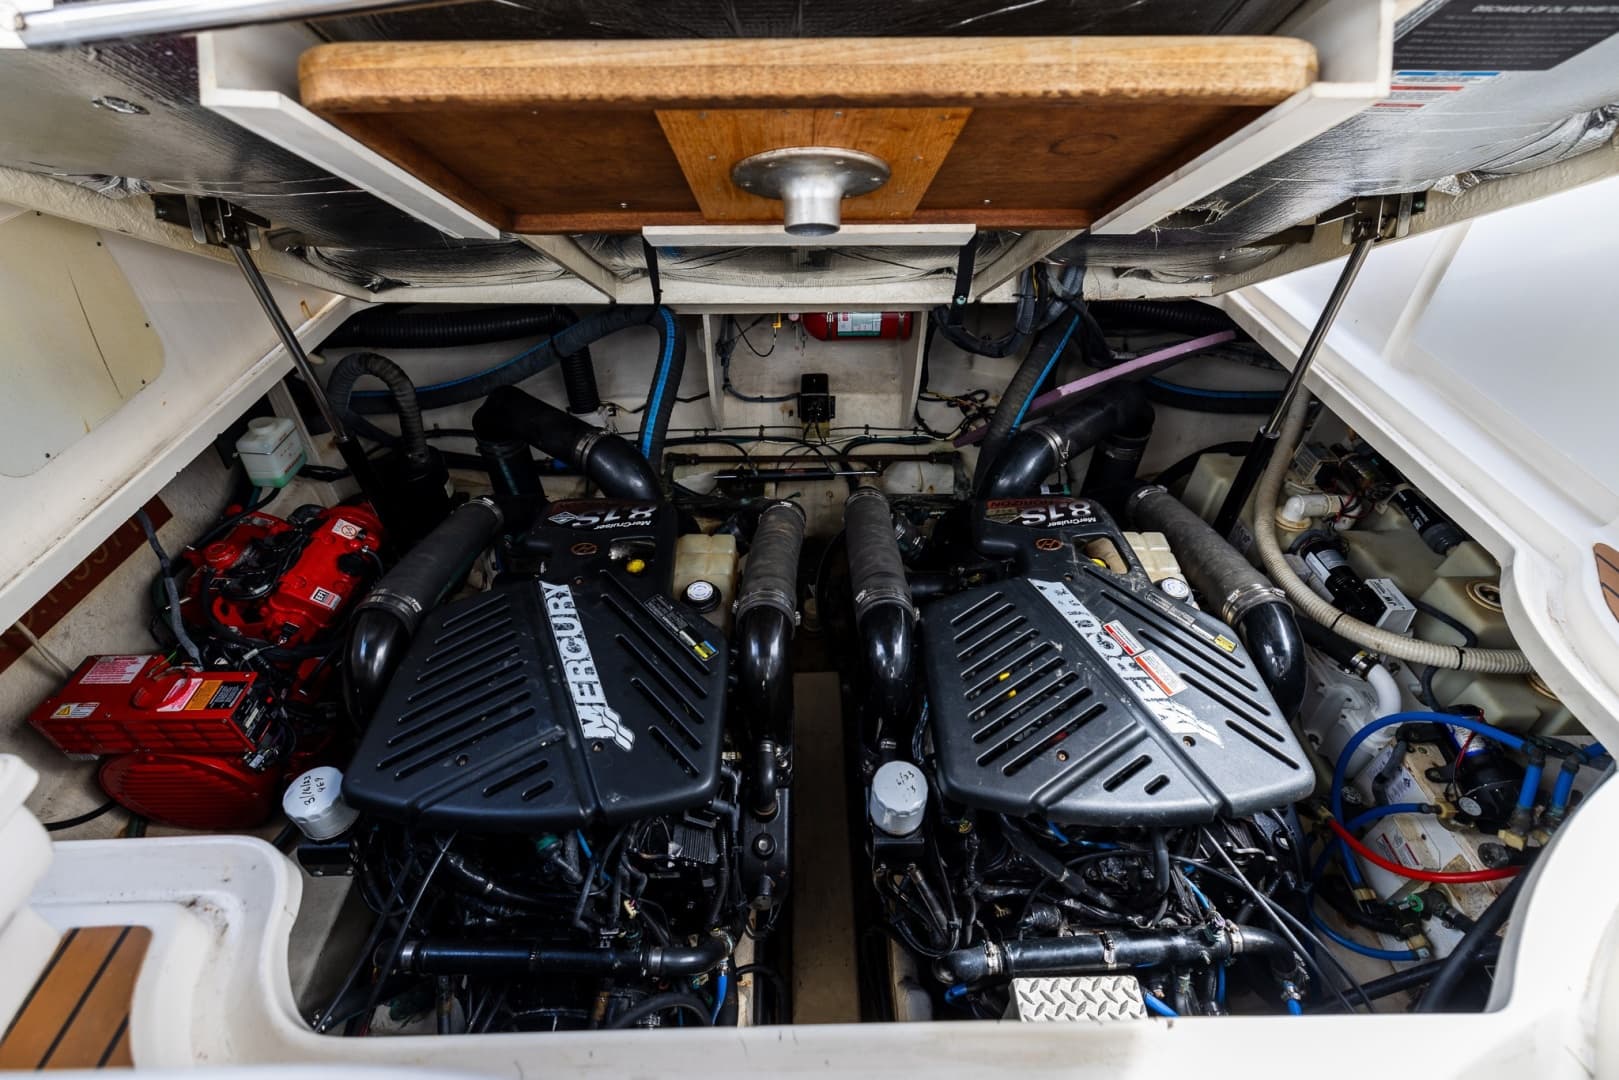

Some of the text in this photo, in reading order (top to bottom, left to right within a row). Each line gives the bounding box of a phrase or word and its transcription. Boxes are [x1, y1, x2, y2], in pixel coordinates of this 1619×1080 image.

[593, 520, 652, 530] MerCruiser
[1047, 517, 1098, 528] MerCruiser
[538, 580, 618, 740] MERCURY
